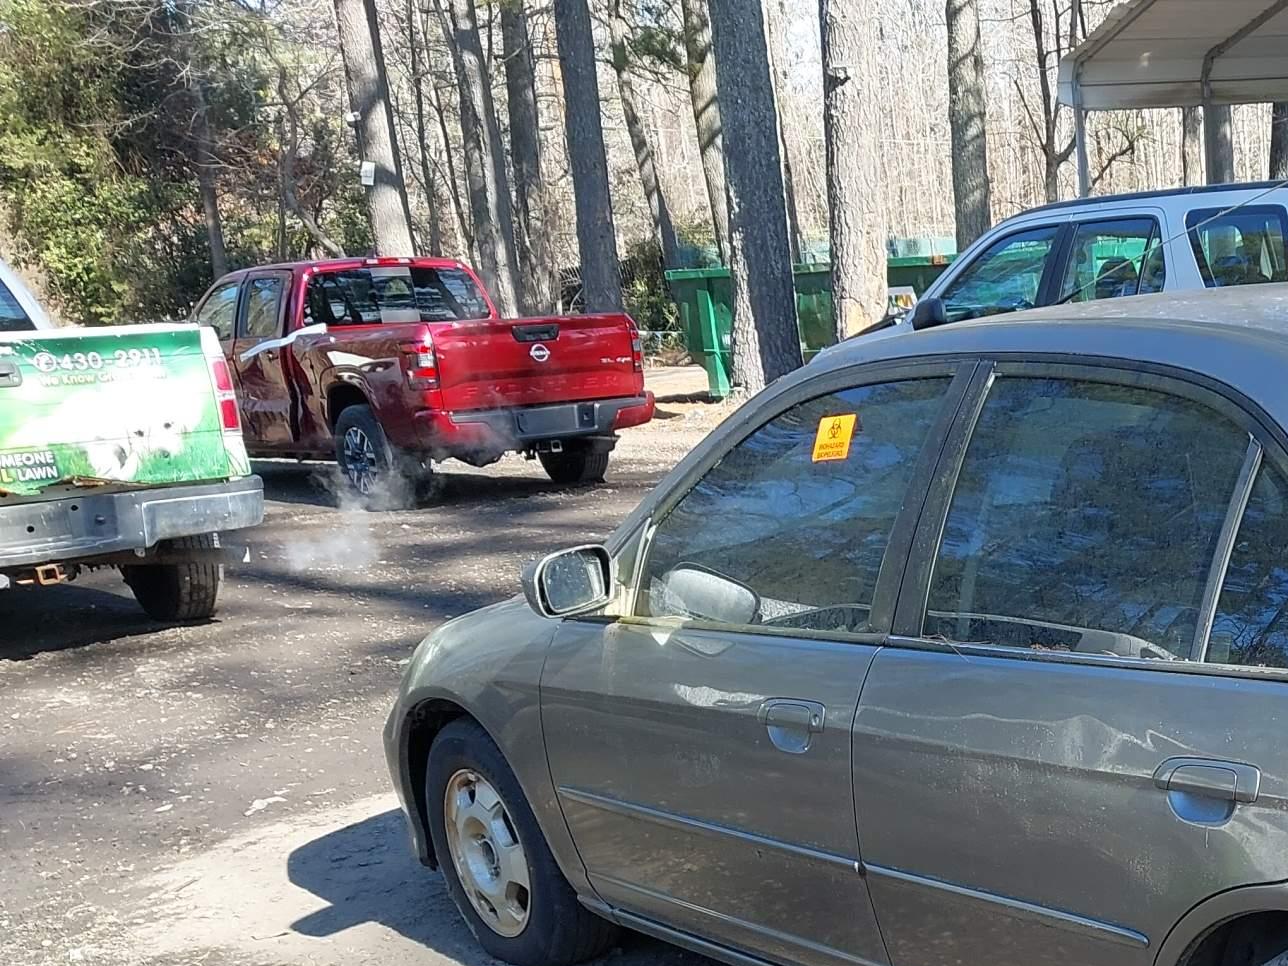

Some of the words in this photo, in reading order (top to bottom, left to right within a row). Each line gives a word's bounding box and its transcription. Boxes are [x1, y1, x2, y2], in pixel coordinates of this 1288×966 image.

[62, 373, 97, 385] Know
[0, 450, 54, 468] MEONE
[17, 465, 58, 481] LAWN
